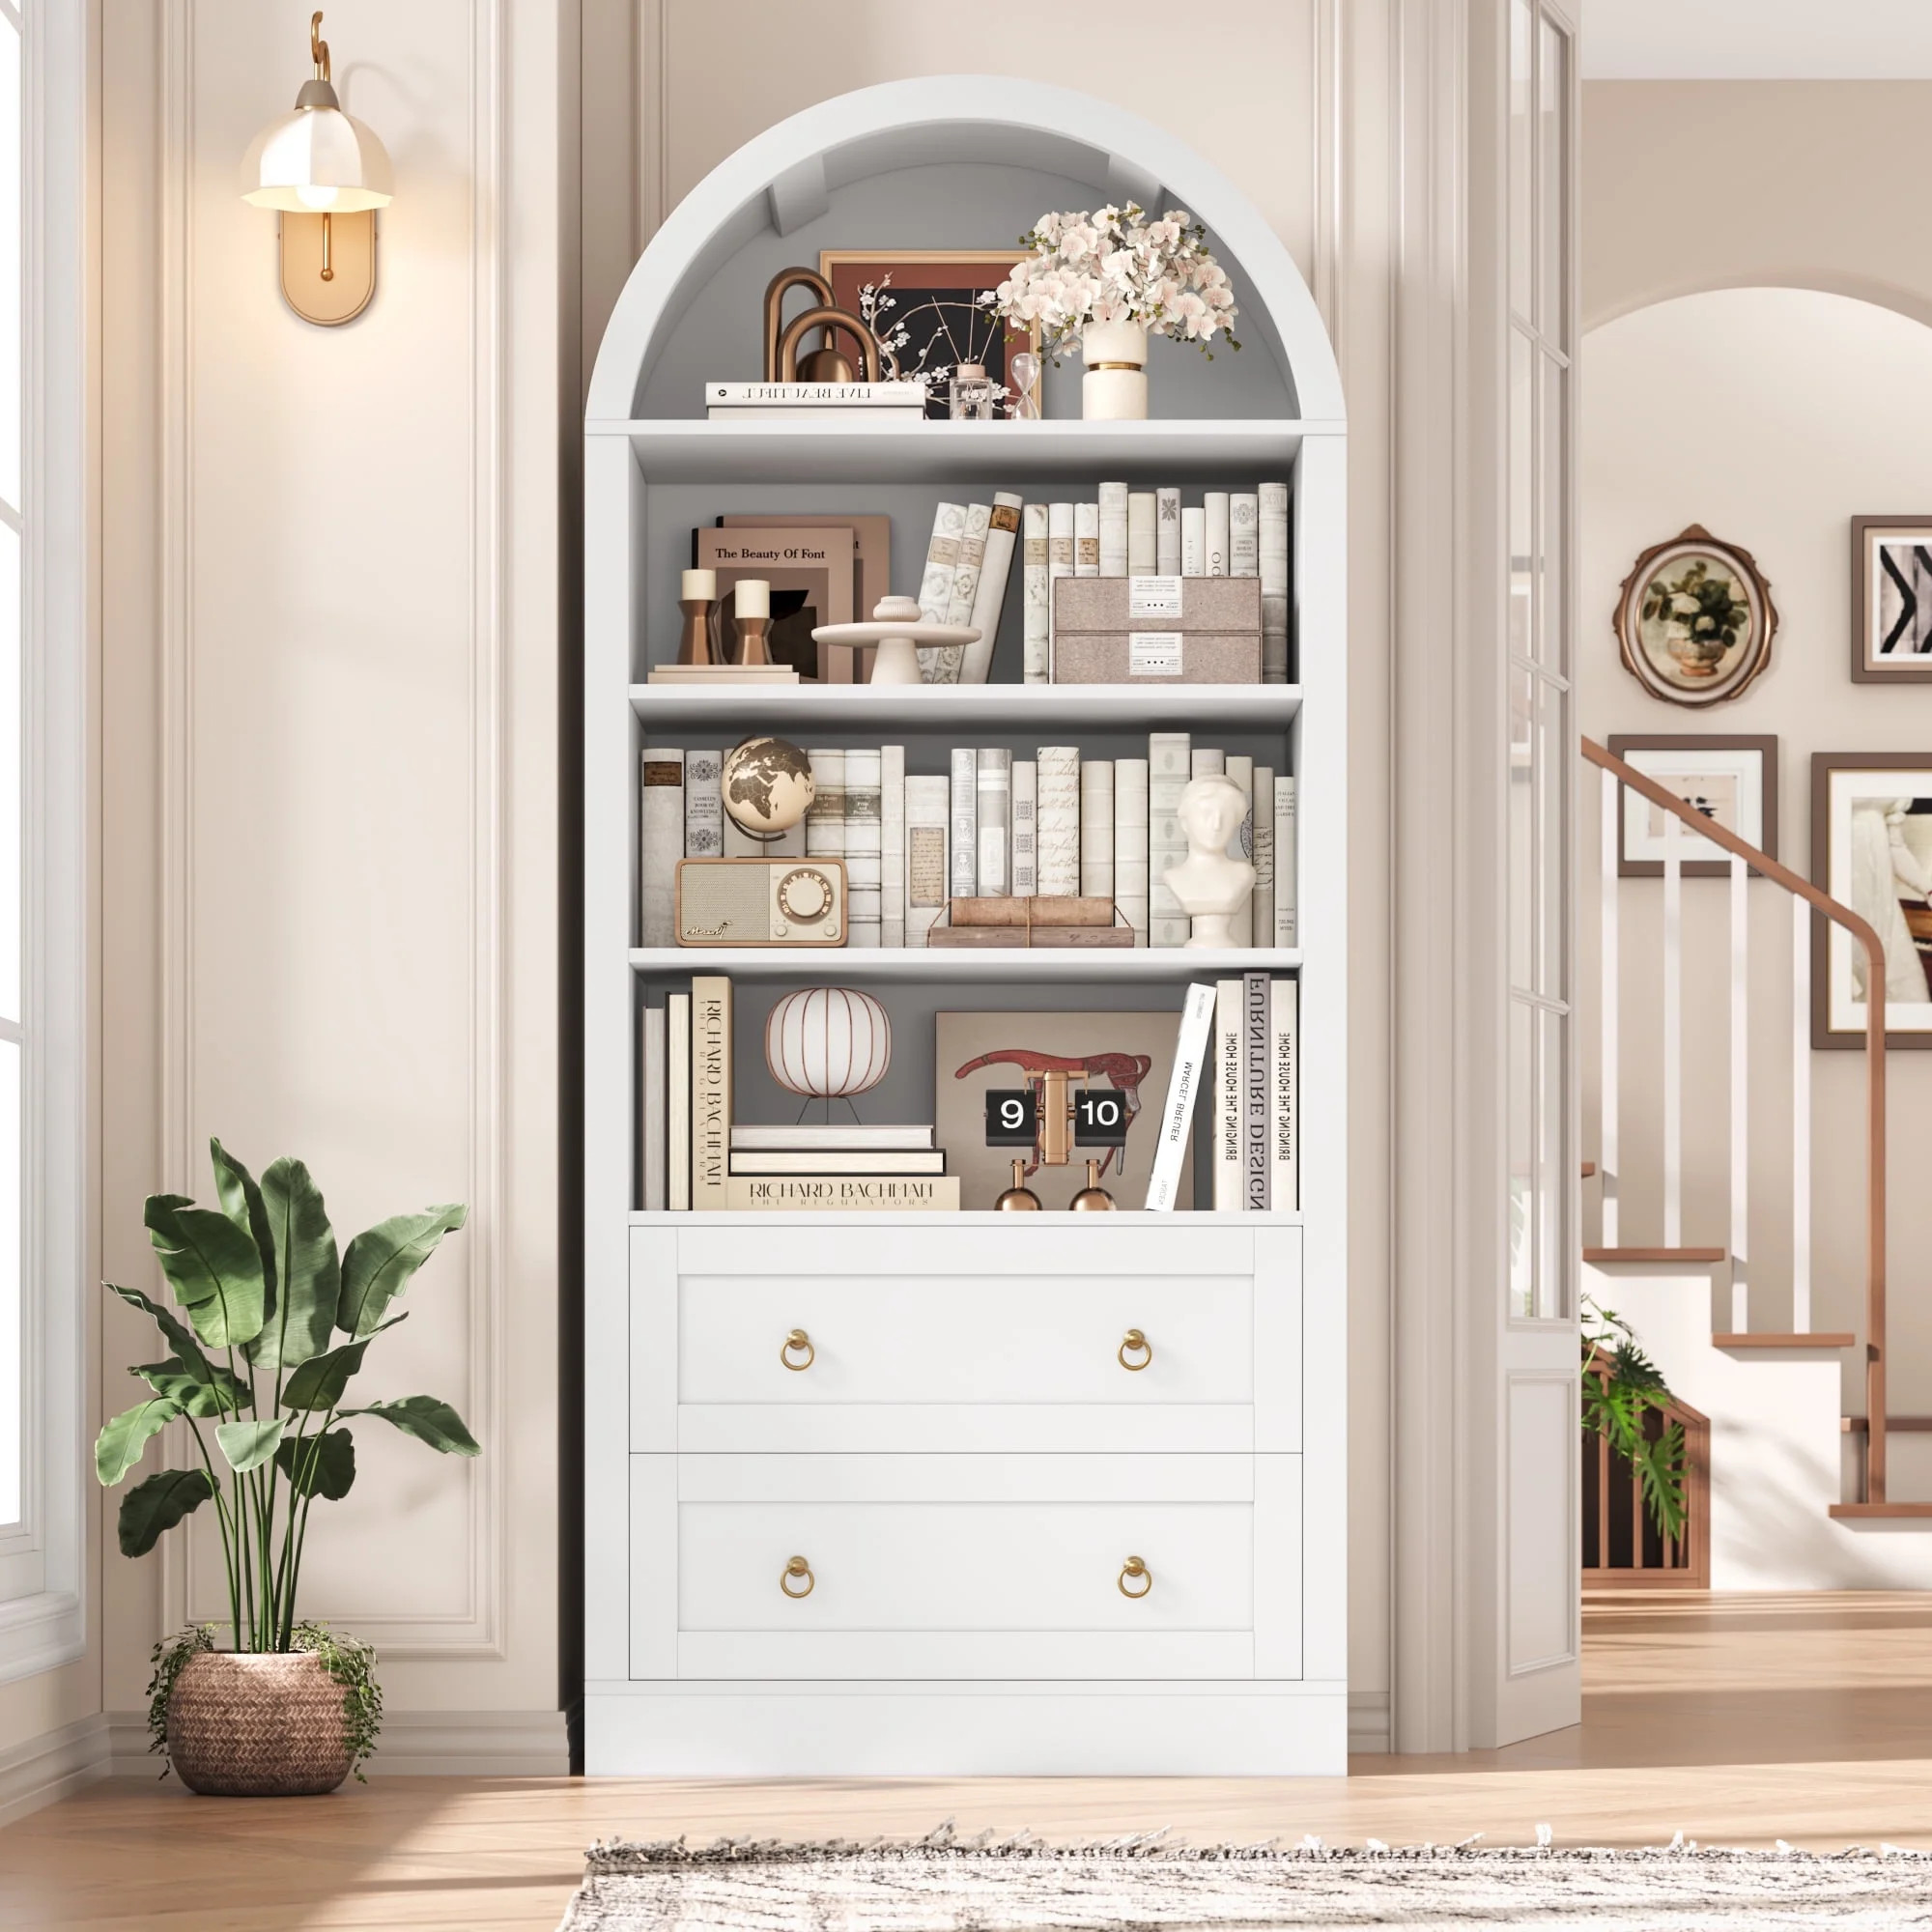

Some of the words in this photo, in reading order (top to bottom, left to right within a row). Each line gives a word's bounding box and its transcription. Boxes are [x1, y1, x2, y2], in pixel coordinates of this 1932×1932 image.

[715, 548, 737, 558] The
[741, 548, 780, 561] Beauty
[783, 548, 799, 558] Of
[801, 548, 826, 558] Font
[706, 1000, 722, 1085] RICHARD
[1000, 1099, 1025, 1129] 9
[1080, 1100, 1120, 1126] 10
[706, 1093, 722, 1186] BACHMAN
[750, 1182, 834, 1198] RICHARD
[841, 1182, 933, 1198] BACHMAN
